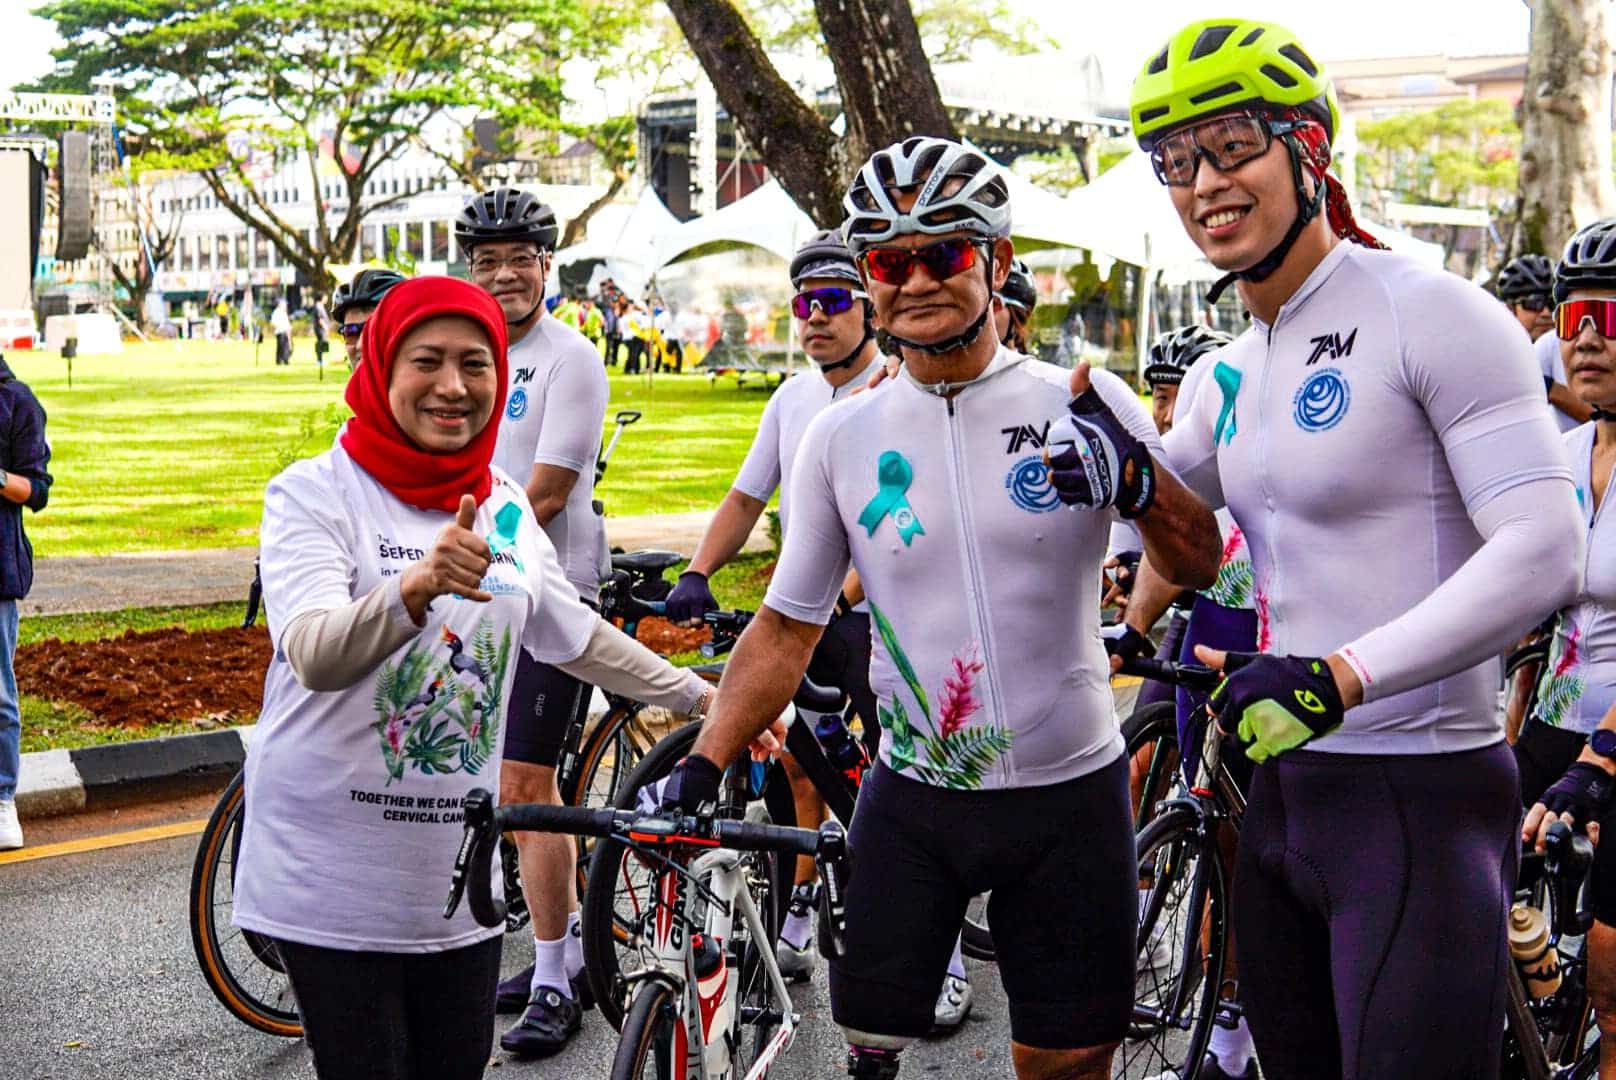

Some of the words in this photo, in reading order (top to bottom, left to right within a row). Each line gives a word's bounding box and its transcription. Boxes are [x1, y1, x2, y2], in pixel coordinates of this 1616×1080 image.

[350, 789, 415, 808] TOGETHER
[417, 798, 436, 809] WE
[437, 798, 458, 809] CAN
[383, 809, 441, 823] CERVICAL
[442, 812, 466, 824] CAN
